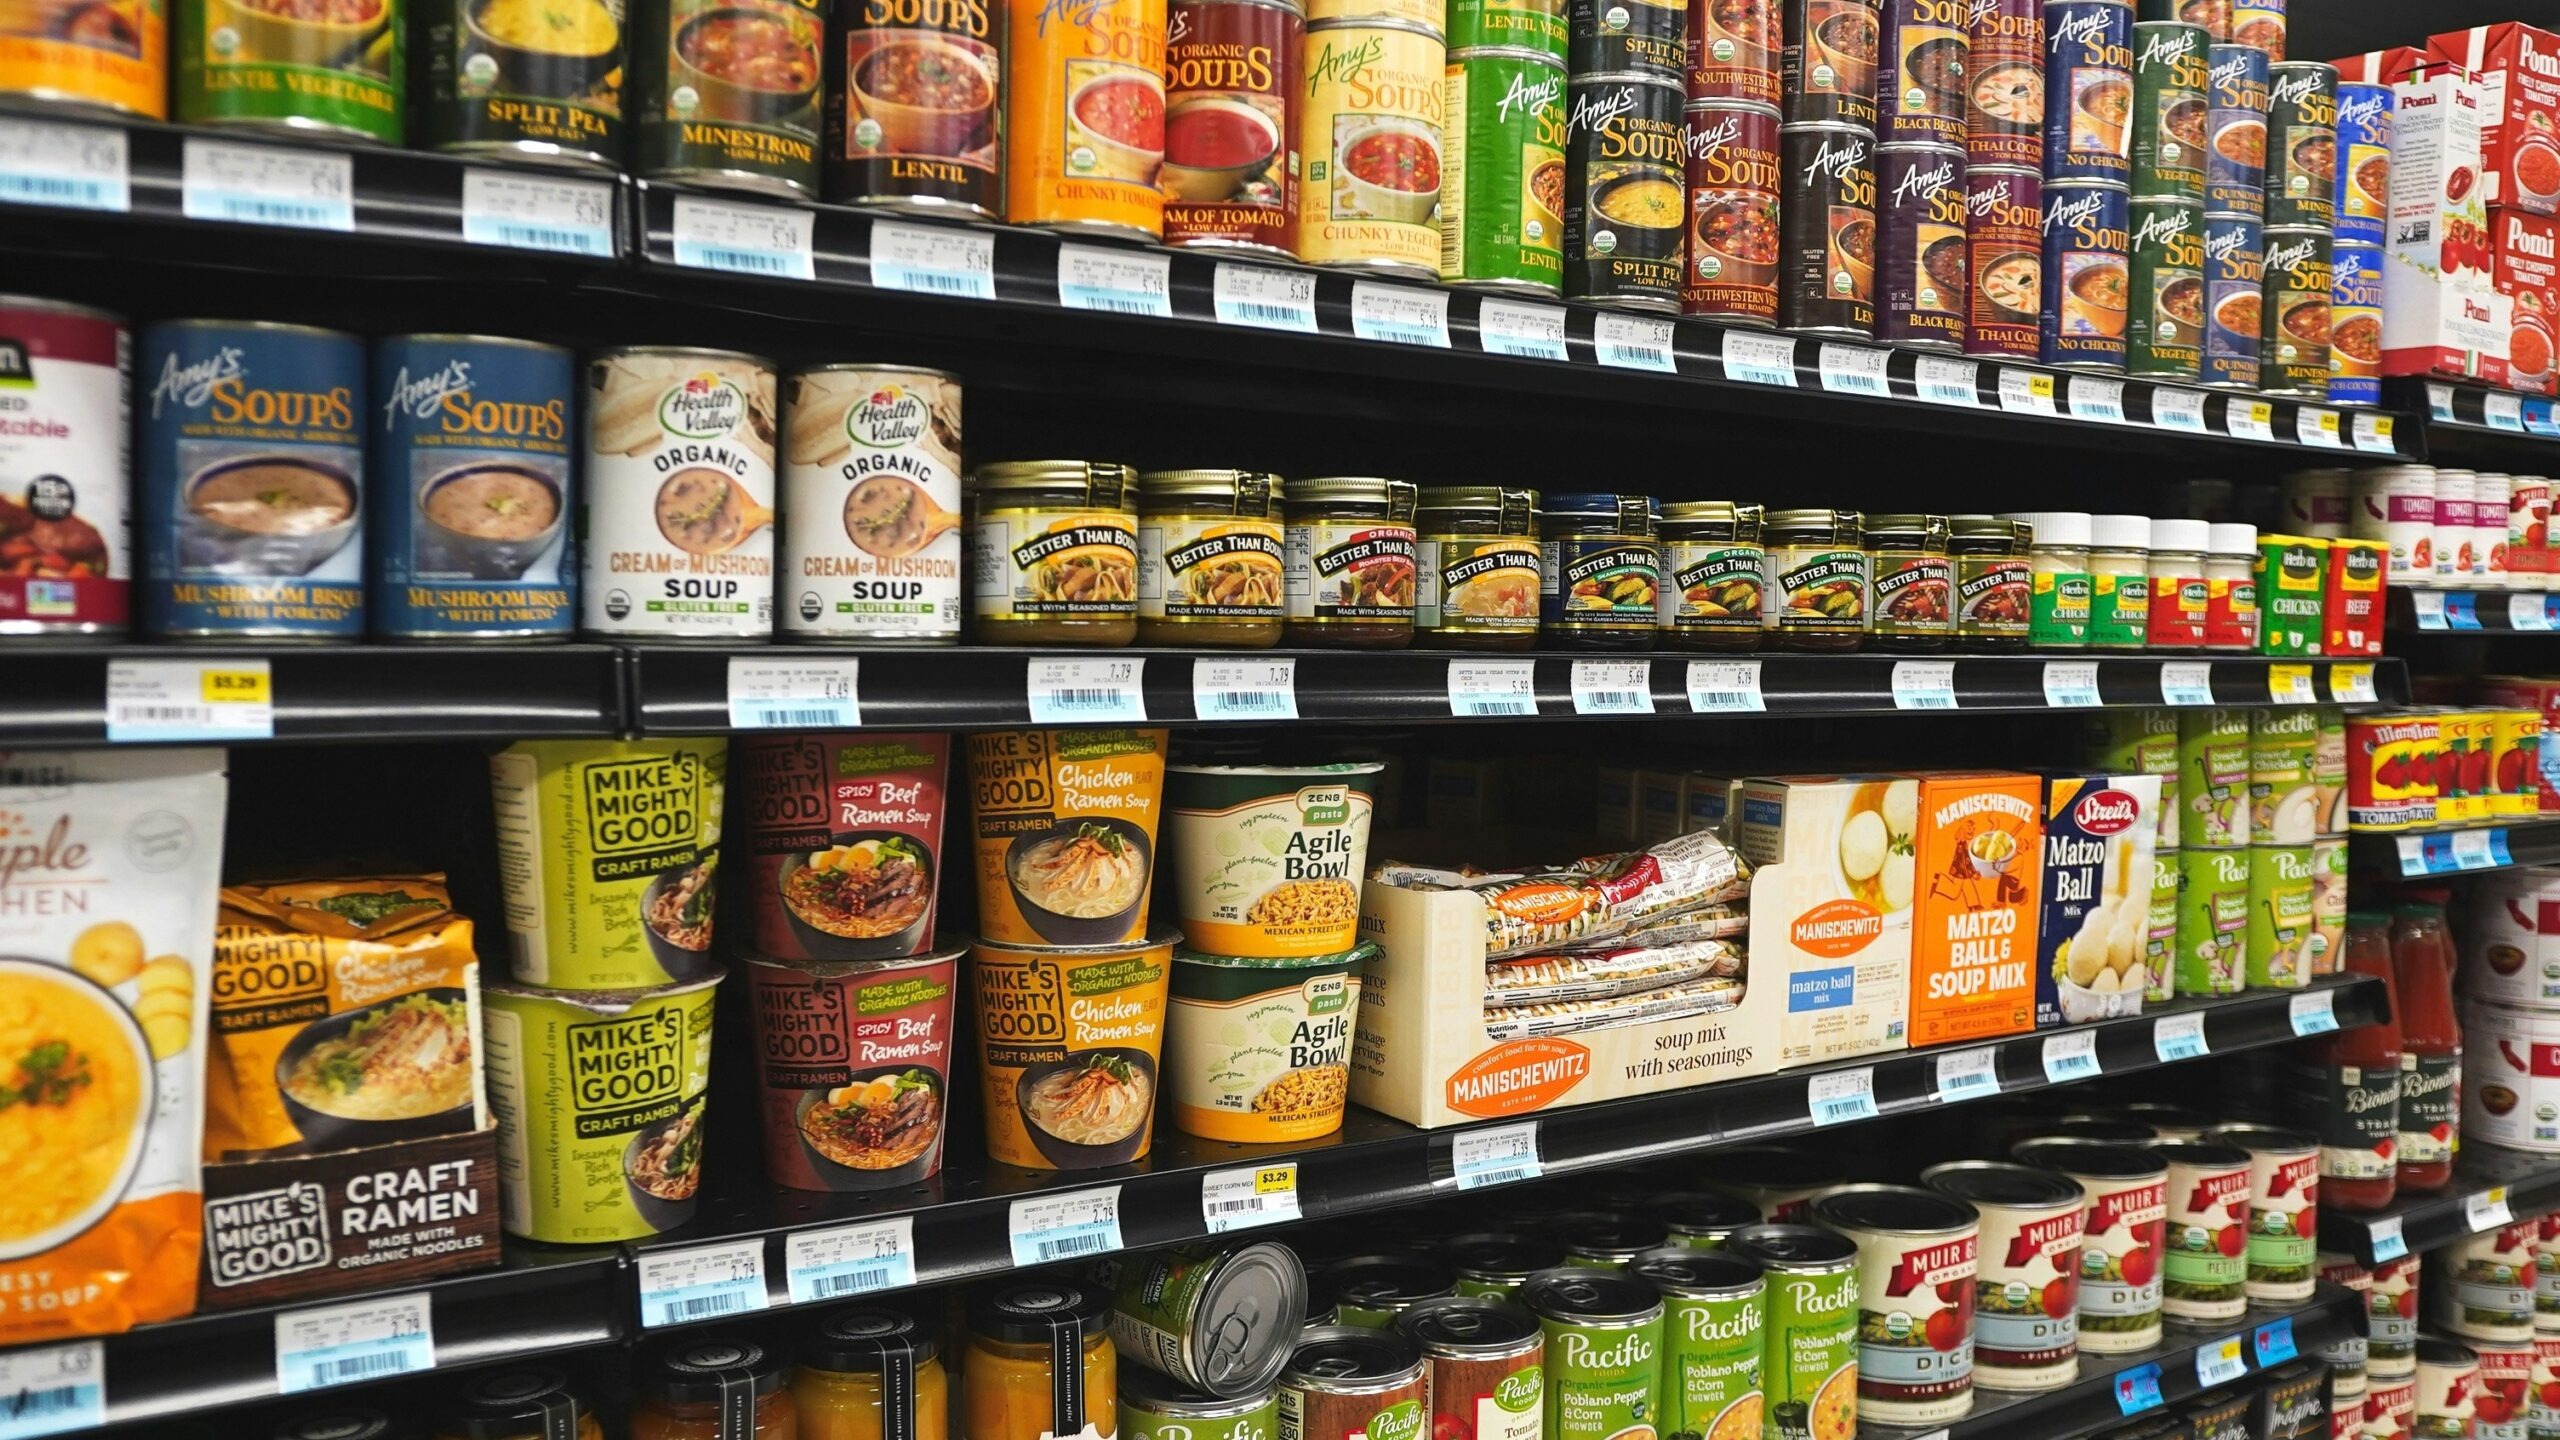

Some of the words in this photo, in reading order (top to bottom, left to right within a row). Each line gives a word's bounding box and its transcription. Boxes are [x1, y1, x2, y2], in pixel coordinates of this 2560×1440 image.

[1485, 14, 1536, 33] LENTIL
[2050, 7, 2113, 53] Amy's
[1182, 45, 1244, 57] ORGANIC
[1626, 38, 1668, 56] SPLIT
[2137, 31, 2197, 73] Amy's
[1309, 37, 1383, 98] Amy's
[1349, 67, 1442, 123] SOUPS
[1496, 72, 1561, 123] Amy's
[2269, 71, 2325, 112] Amy's
[488, 100, 561, 127] SPLIT
[567, 108, 607, 136] PEA
[1566, 86, 1636, 144] Amy's
[1630, 118, 1676, 134] ORGANIC
[1894, 117, 1930, 129] BLACK
[682, 123, 812, 162] MINESTRONE
[1602, 117, 1686, 168] SOUPS
[1734, 146, 1774, 161] ORGANIC
[1970, 140, 2005, 152] THAI
[891, 159, 967, 184] LENTIL
[1804, 140, 1866, 188] Amy's
[1056, 184, 1117, 201] CHUNKY
[1195, 210, 1216, 223] OF
[1222, 210, 1285, 228] TOMATO
[2042, 192, 2105, 236] Amy's
[1189, 224, 1212, 232] LOW
[1215, 224, 1232, 232] FAT
[966, 252, 989, 270] 5.19
[1613, 261, 1657, 278] SPLIT
[1663, 268, 1681, 282] PEA
[1291, 284, 1309, 299] 5.19
[1682, 290, 1762, 303] SOUTHWESTERN
[1654, 325, 1669, 342] 5.19
[151, 346, 249, 419] Amy's
[211, 378, 352, 429] SOUPS
[385, 359, 475, 432] Amy's
[671, 392, 733, 413] Health
[441, 388, 564, 440] SOUPS
[685, 409, 737, 432] Valley
[859, 399, 916, 424] Health
[870, 420, 920, 442] Valley
[654, 445, 748, 476] ORGANIC
[842, 454, 931, 482] ORGANIC
[1017, 535, 1072, 564] BETTER
[1075, 529, 1112, 544] THAN
[1369, 531, 1412, 539] ORGANIC
[610, 553, 670, 573] CREAM
[1171, 543, 1222, 569] BETTER
[1226, 536, 1261, 550] THAN
[1320, 545, 1370, 574] BETTER
[1373, 541, 1406, 554] THAN
[1724, 550, 1760, 558] ORGANIC
[804, 557, 859, 577] CREAM
[1445, 559, 1494, 584] BETTER
[1497, 554, 1526, 567] THAN
[1569, 557, 1614, 581] BETTER
[1617, 553, 1645, 565] THAN
[408, 588, 526, 607] MUSHROOM
[665, 579, 737, 598] SOUP
[853, 581, 922, 599] SOUP
[449, 609, 494, 621] WITH
[852, 603, 896, 613] GLUTEN
[899, 603, 927, 612] FREE
[1016, 603, 1040, 611] MADE
[1042, 603, 1065, 611] WITH
[1068, 603, 1109, 611] SEASONED
[2273, 598, 2321, 615] CHICKEN
[2346, 599, 2371, 615] BEEF
[213, 676, 257, 690] $5.29
[1110, 664, 1131, 679] 7.79
[1270, 667, 1288, 682] 7.79
[1512, 680, 1528, 694] 5.99
[594, 760, 693, 794] MIKE'S
[1057, 764, 1133, 791] Chicken
[598, 787, 693, 819] MIGHTY
[838, 786, 872, 797] SPICY
[879, 782, 921, 803] Beef
[1063, 787, 1122, 809] Ramen
[1125, 794, 1150, 812] Soup
[1308, 794, 1340, 802] ZENB
[841, 803, 904, 825] Ramen
[907, 809, 931, 828] Soup
[1313, 810, 1343, 820] pasta
[1936, 793, 2033, 828] MANISCHEWITZ
[2078, 797, 2134, 824] Streit's
[601, 809, 692, 845] GOOD
[1285, 829, 1352, 860] Agile
[2048, 837, 2104, 866] Matzo
[598, 856, 647, 876] CRAFT
[650, 850, 694, 870] RAMEN
[1285, 854, 1349, 879] Bowl
[2057, 871, 2093, 901] Ball
[2064, 906, 2082, 916] Mix
[1796, 914, 1880, 941] MANISCHEWITZ
[1948, 908, 2016, 939] MATZO
[1951, 939, 1998, 963] BALL
[2001, 942, 2011, 959] &
[861, 985, 894, 997] MADE
[897, 980, 922, 993] WITH
[980, 967, 1052, 991] MIKE'S
[1792, 979, 1828, 994] matzo
[1831, 975, 1851, 989] ball
[1929, 973, 1985, 999] SOUP
[1989, 963, 2026, 988] MIX
[858, 997, 908, 1011] ORGANIC
[910, 985, 947, 1004] NOODLES
[982, 993, 1055, 1012] MIGHTY
[1813, 992, 1830, 1003] mix
[987, 1012, 1057, 1036] GOOD
[1654, 1034, 1692, 1052] soup
[1696, 1023, 1727, 1043] mix
[1625, 1055, 1664, 1080] with
[1667, 1044, 1753, 1074] seasonings
[1453, 1053, 1586, 1104] MANISCHEWITZ
[1268, 1114, 1306, 1123] MEXICAN
[1309, 1111, 1332, 1120] STREET
[346, 1160, 474, 1204] CRAFT
[1263, 1172, 1288, 1183] $3.29
[342, 1189, 478, 1235] RAMEN
[1093, 1206, 1113, 1223] 2.79
[368, 1232, 411, 1249] MADE
[416, 1226, 455, 1243] WITH
[2030, 1221, 2071, 1245] MUIR
[221, 1236, 320, 1278] GOOD
[337, 1247, 409, 1269] ORGANIC
[413, 1235, 483, 1257] NOODLES
[874, 1240, 897, 1258] 2.79
[1912, 1247, 1960, 1274] MUIR
[731, 1263, 755, 1281] 2.79
[1679, 1303, 1762, 1342] Pacific
[1557, 1333, 1652, 1368] Pacific
[1501, 1371, 1541, 1402] Pacific
[1564, 1392, 1611, 1405] Poblano
[1614, 1387, 1647, 1406] Pepper
[1565, 1409, 1575, 1420] &
[1575, 1407, 1602, 1420] Corn
[1505, 1419, 1539, 1438] Tomato
[1564, 1421, 1602, 1432] CHOWDER
